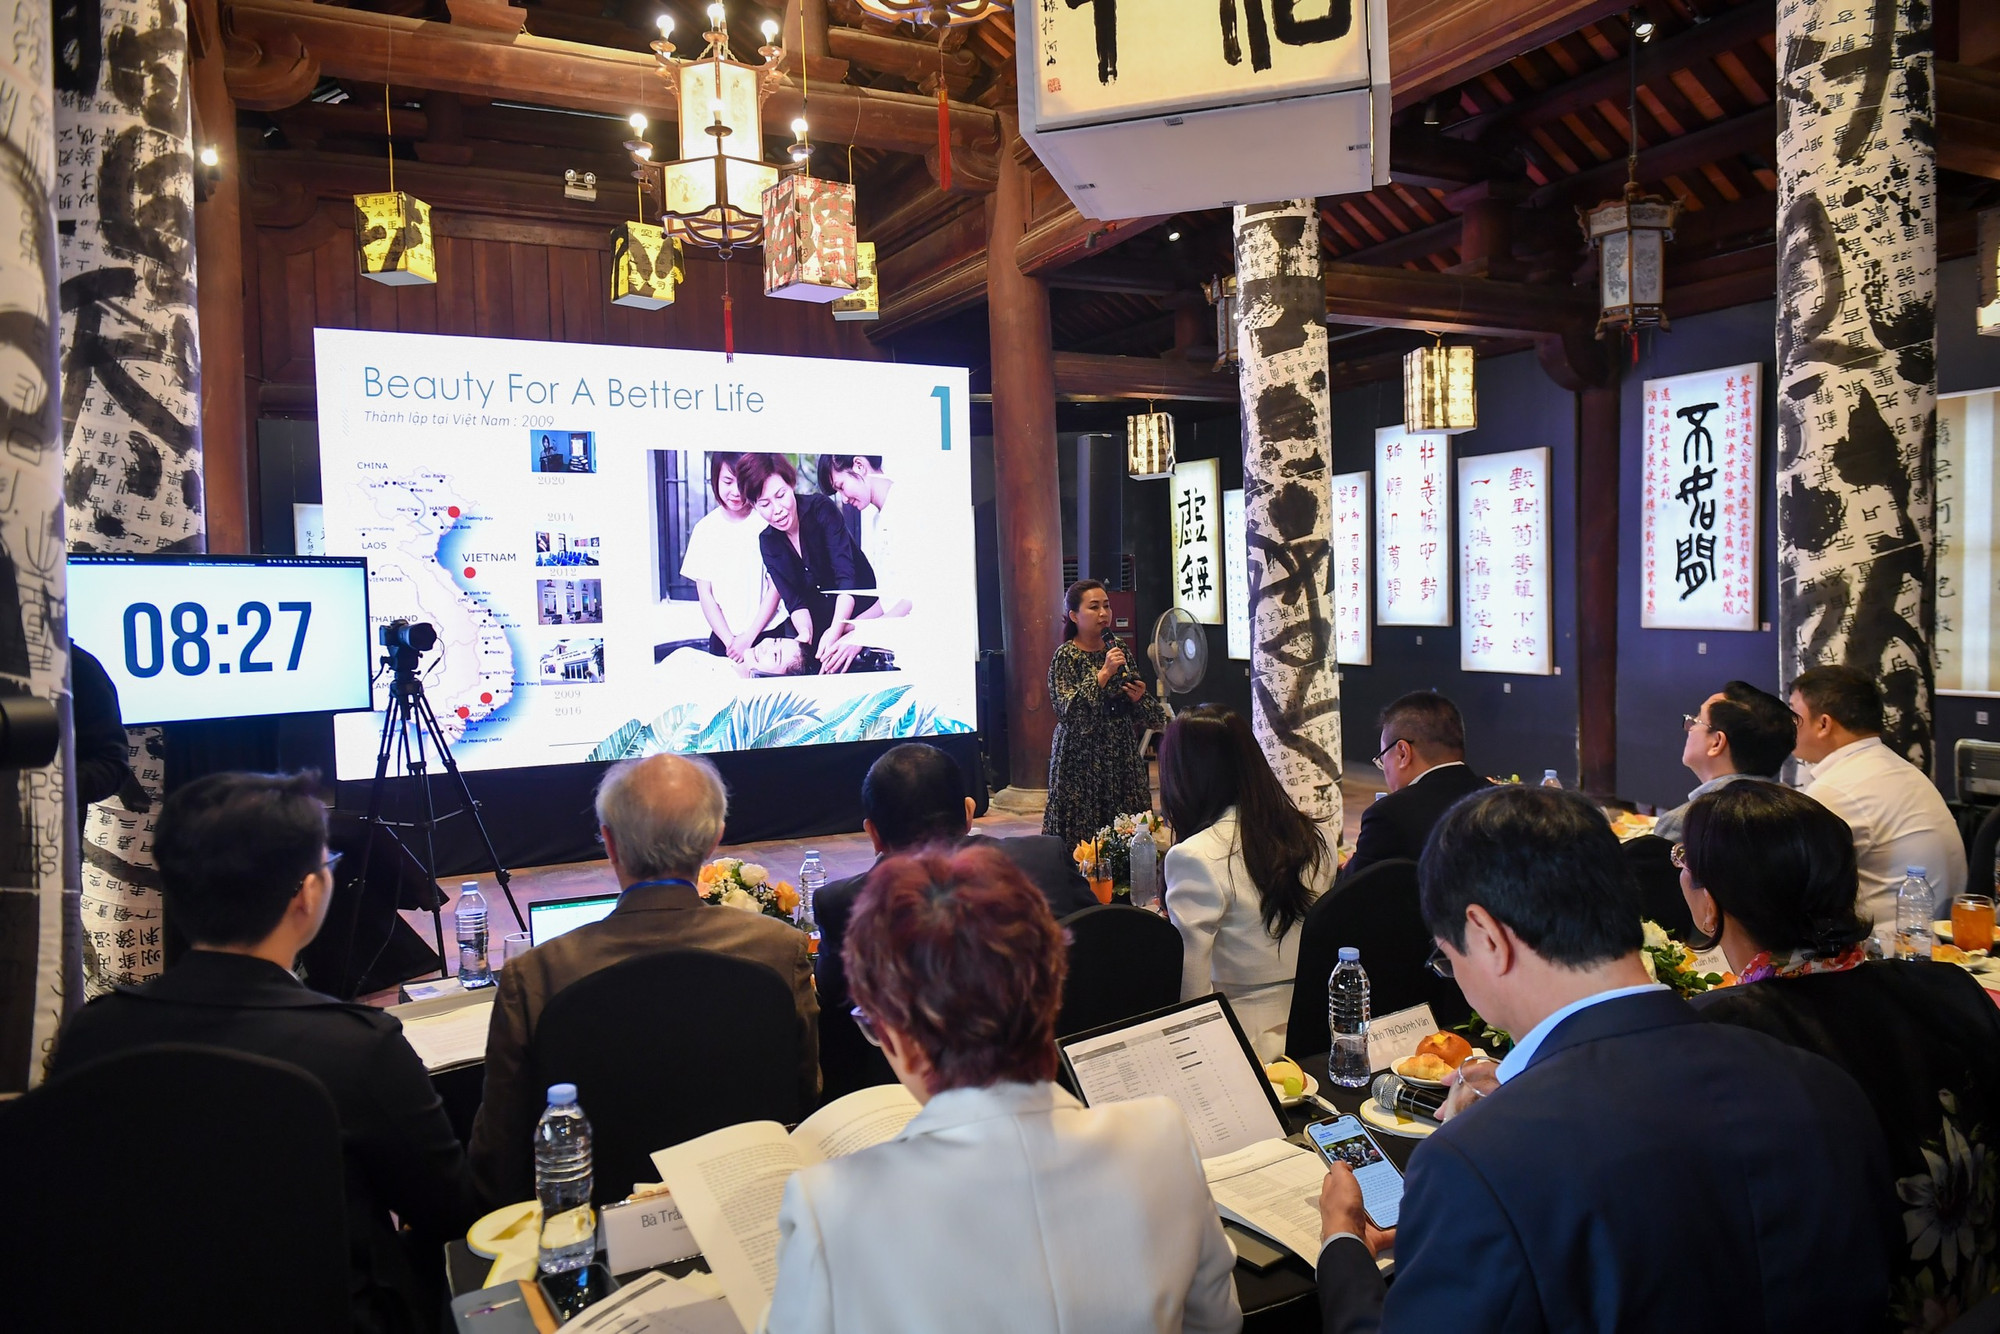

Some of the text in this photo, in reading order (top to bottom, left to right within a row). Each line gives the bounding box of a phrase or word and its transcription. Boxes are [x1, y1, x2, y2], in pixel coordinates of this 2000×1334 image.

[363, 366, 765, 414] Beauty For A Better Life
[364, 410, 405, 425] Thành
[407, 411, 429, 429] lập
[430, 412, 449, 428] tại
[452, 411, 477, 429] Việt
[481, 415, 510, 428] Nam
[521, 414, 555, 429] 2009
[930, 385, 952, 450] 1
[357, 462, 389, 470] CHINA
[538, 475, 565, 486] 2020
[547, 512, 575, 522] 2014
[361, 541, 387, 550] LAOS
[462, 553, 517, 563] VIETNAM
[550, 567, 577, 577] 2012
[123, 601, 313, 678] 08:27
[554, 689, 582, 700] 2009
[554, 706, 582, 717] 2016
[641, 1212, 657, 1228] Bà
